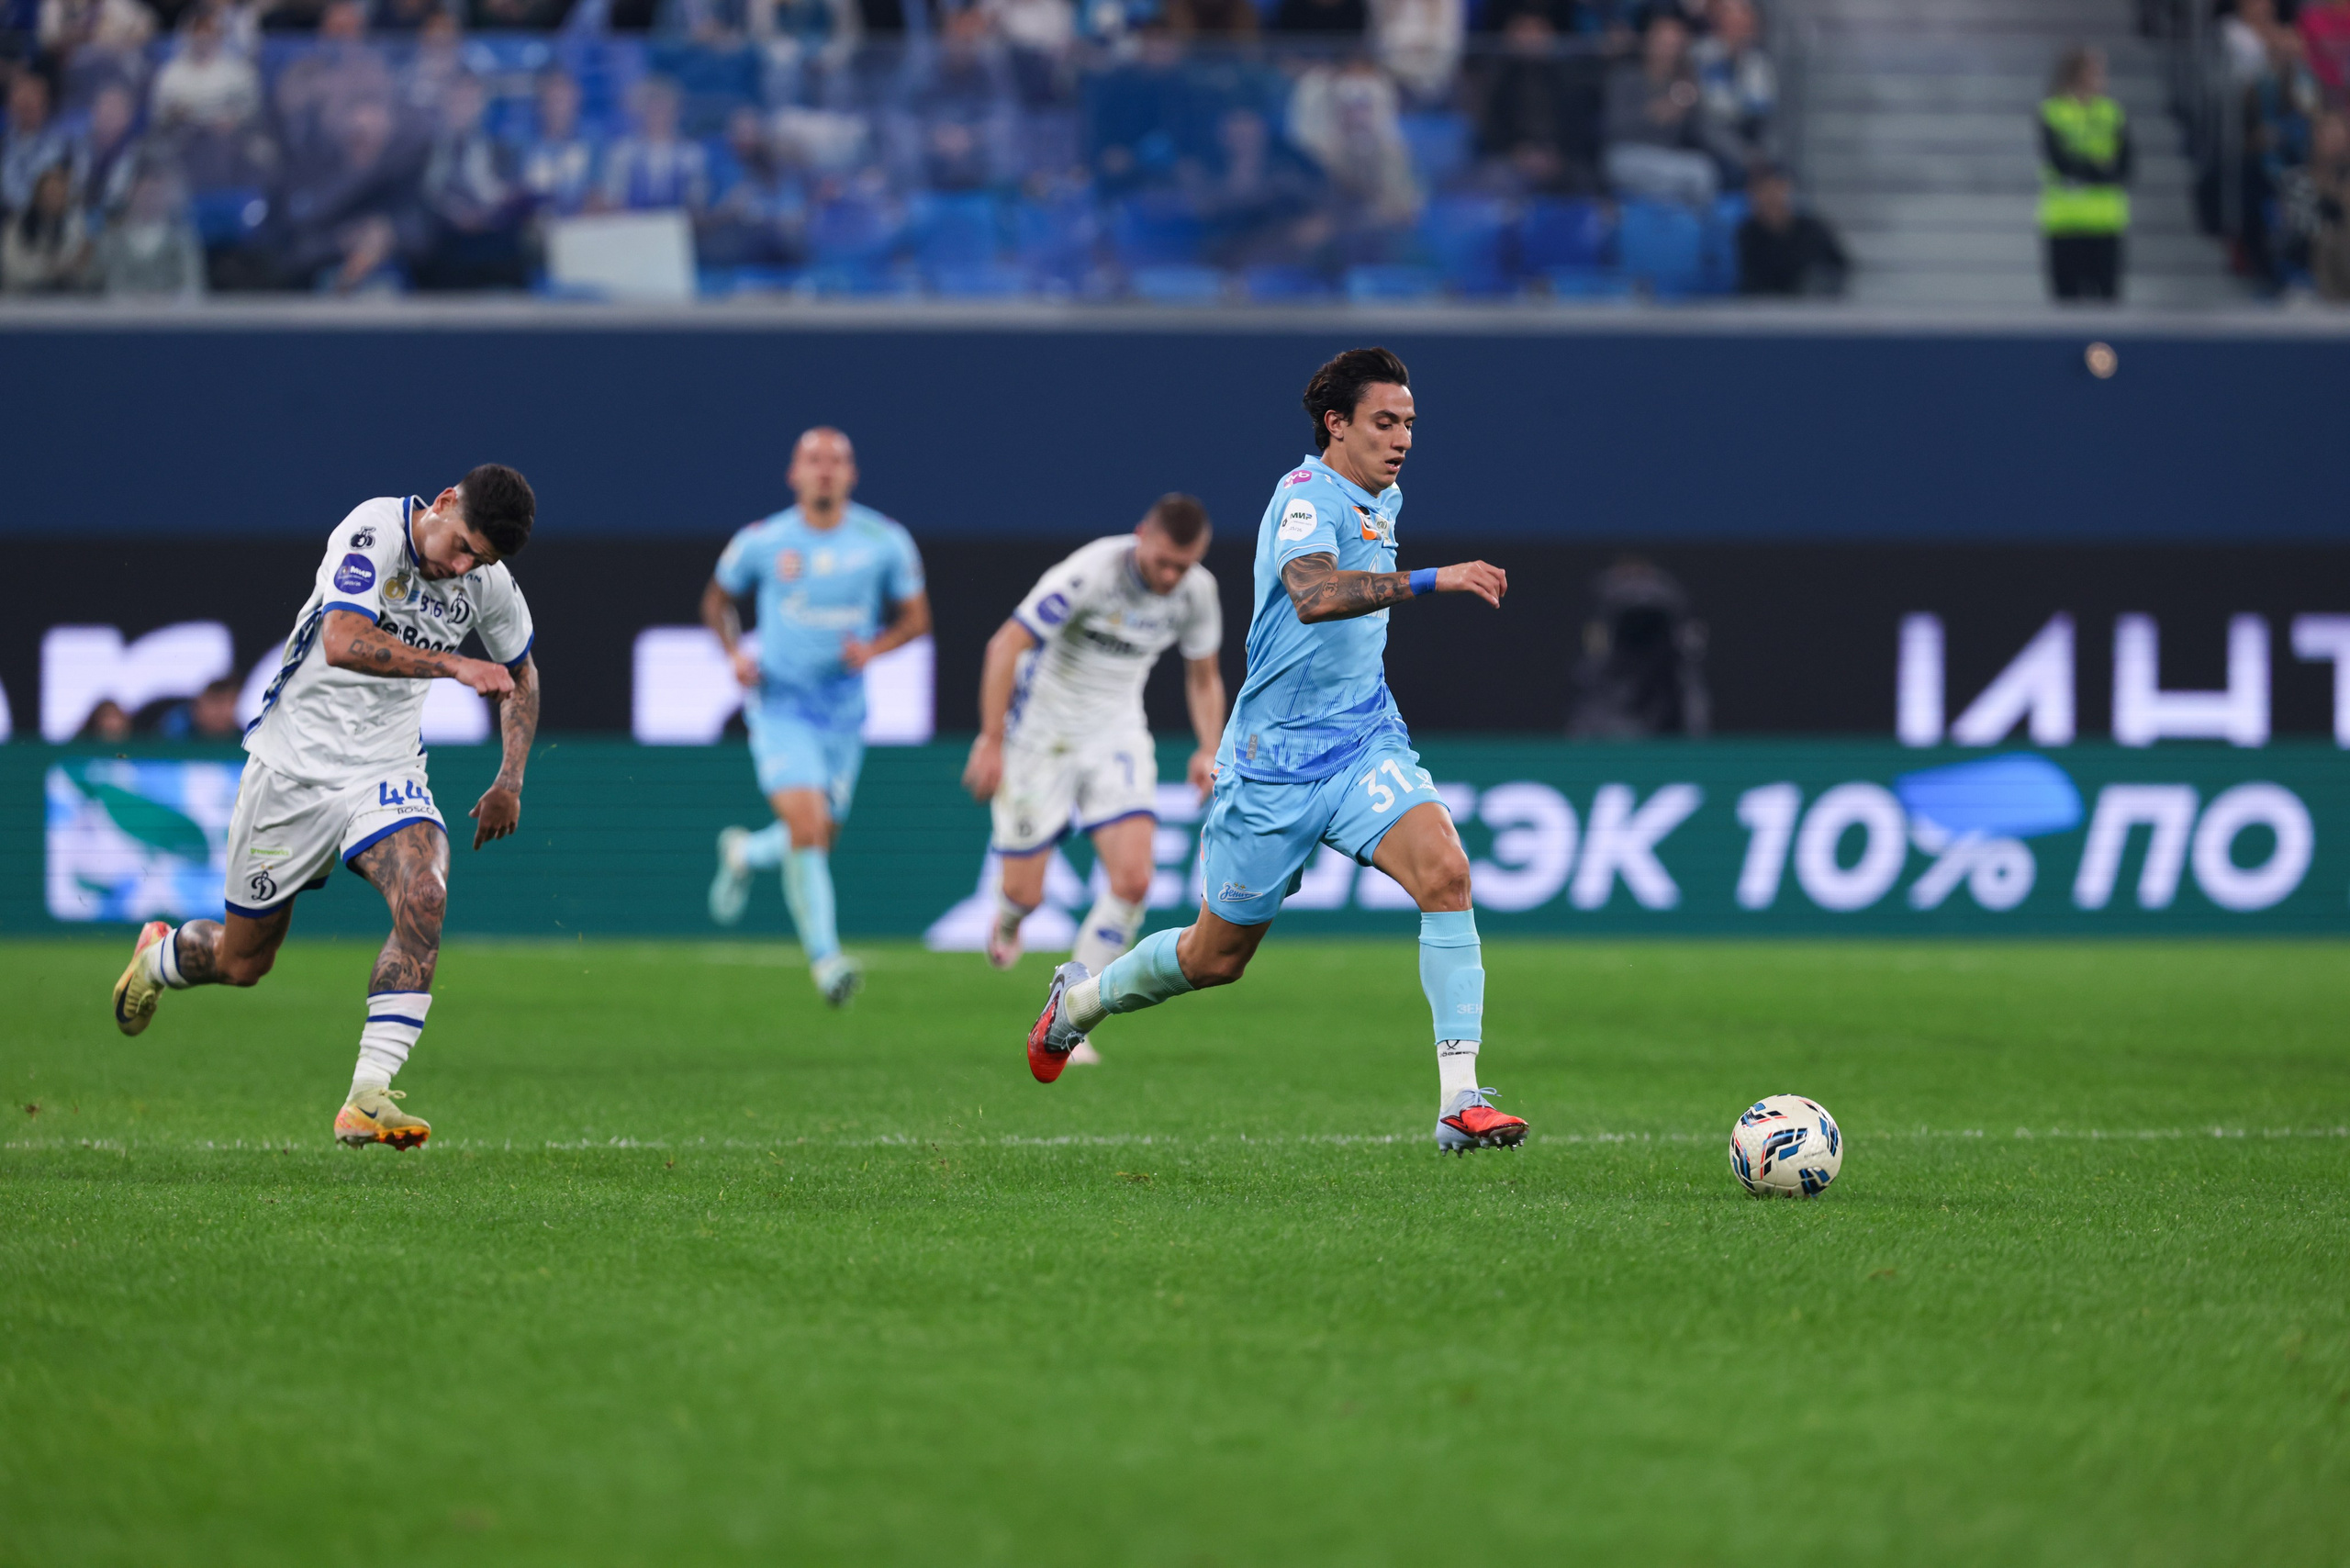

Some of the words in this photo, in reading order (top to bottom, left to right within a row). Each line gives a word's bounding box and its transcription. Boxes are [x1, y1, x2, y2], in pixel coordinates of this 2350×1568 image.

[379, 779, 431, 806] 44
[1359, 758, 1415, 813] 31
[397, 807, 435, 815] BOSCO
[2071, 780, 2315, 912] ПО
